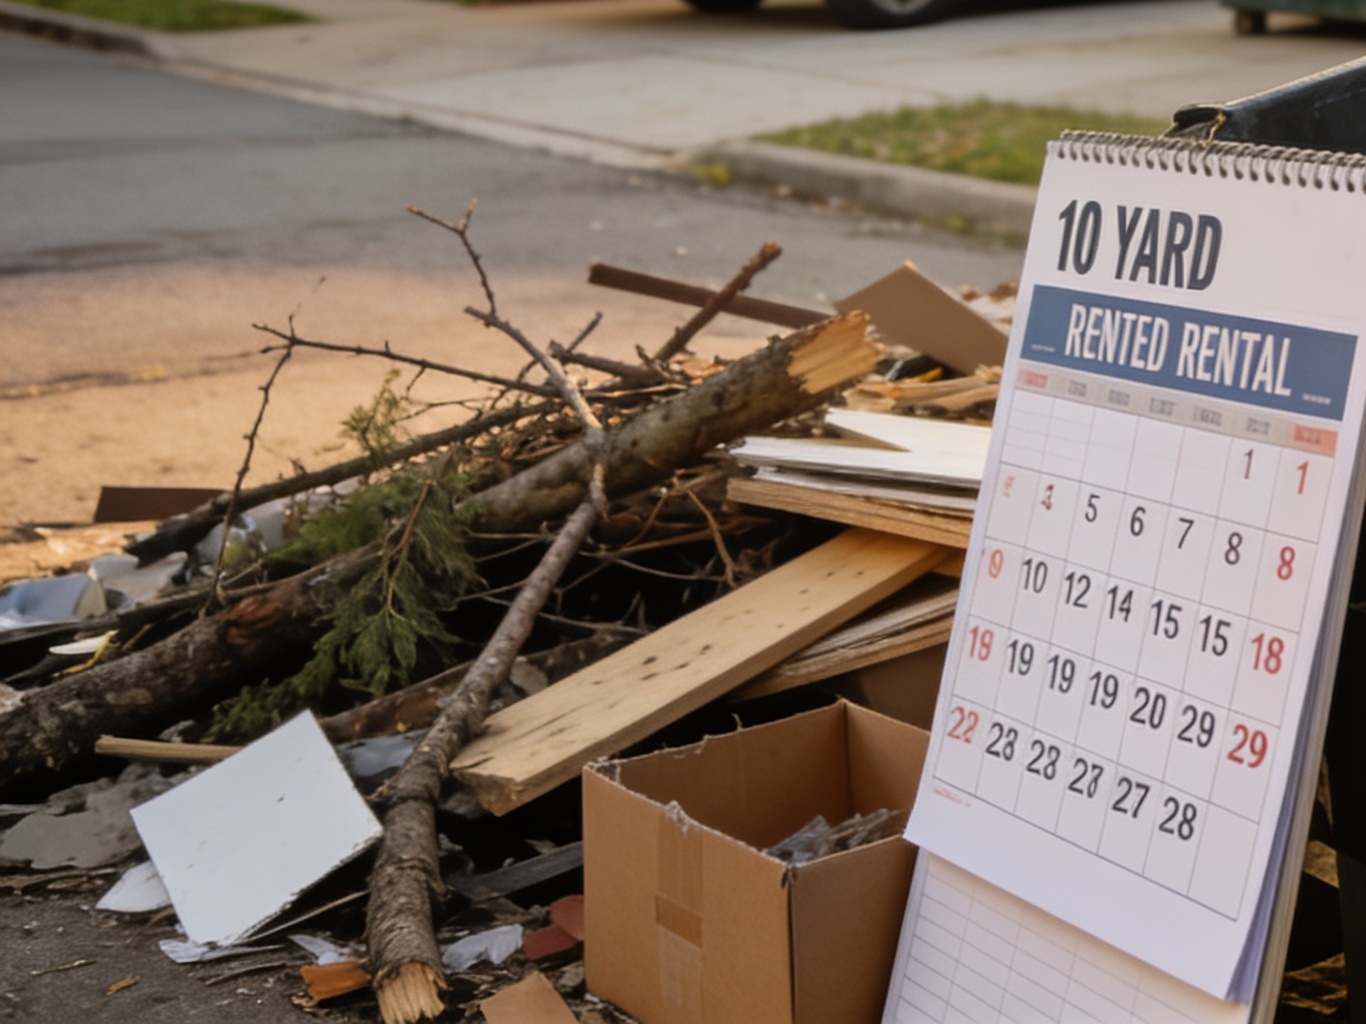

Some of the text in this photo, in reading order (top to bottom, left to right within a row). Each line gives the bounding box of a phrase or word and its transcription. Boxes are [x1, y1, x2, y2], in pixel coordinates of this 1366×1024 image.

[1057, 199, 1224, 291] 10 YARD
[1064, 303, 1292, 397] RENTED RENTAL
[1242, 448, 1310, 495] 1 1
[1084, 493, 1101, 523] 5
[1129, 506, 1147, 537] 6
[1177, 517, 1195, 550] 7
[1223, 532, 1244, 566] 8
[1277, 545, 1296, 581] 8
[1022, 558, 1048, 594] 10
[1065, 571, 1091, 608] 12
[1107, 585, 1134, 623] 14
[1150, 599, 1183, 639] 15
[1200, 614, 1232, 657] 15
[1251, 632, 1285, 675] 18
[1008, 639, 1035, 676] 19
[1048, 654, 1076, 694] 19
[1089, 670, 1119, 709] 19
[1130, 687, 1167, 730] 20
[1177, 705, 1216, 749] 29
[1226, 724, 1270, 769] 29
[1111, 777, 1151, 819] 27
[1158, 796, 1198, 841] 28
